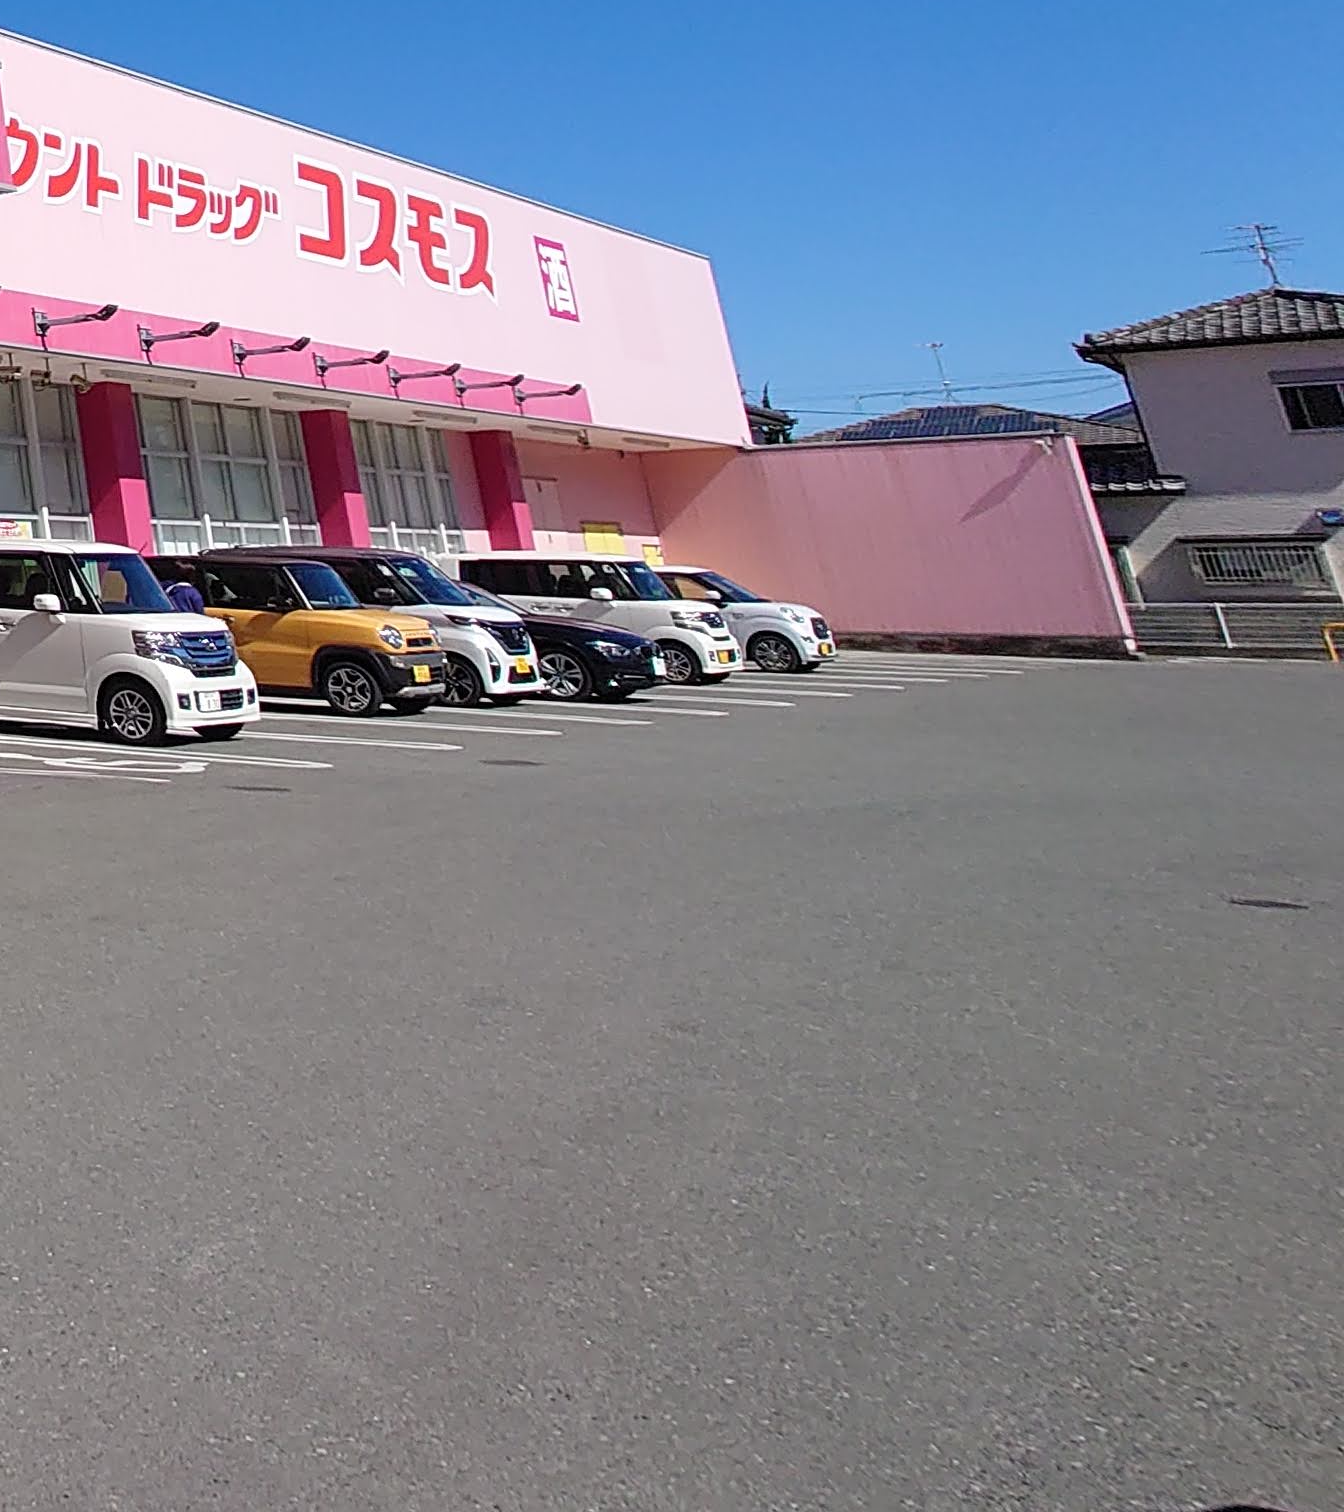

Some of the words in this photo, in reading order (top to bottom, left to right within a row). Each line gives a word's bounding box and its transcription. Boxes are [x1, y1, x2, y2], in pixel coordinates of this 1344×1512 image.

[137, 157, 279, 241] ドラッグ
[296, 159, 496, 298] コスモス
[540, 241, 578, 319] 酒
